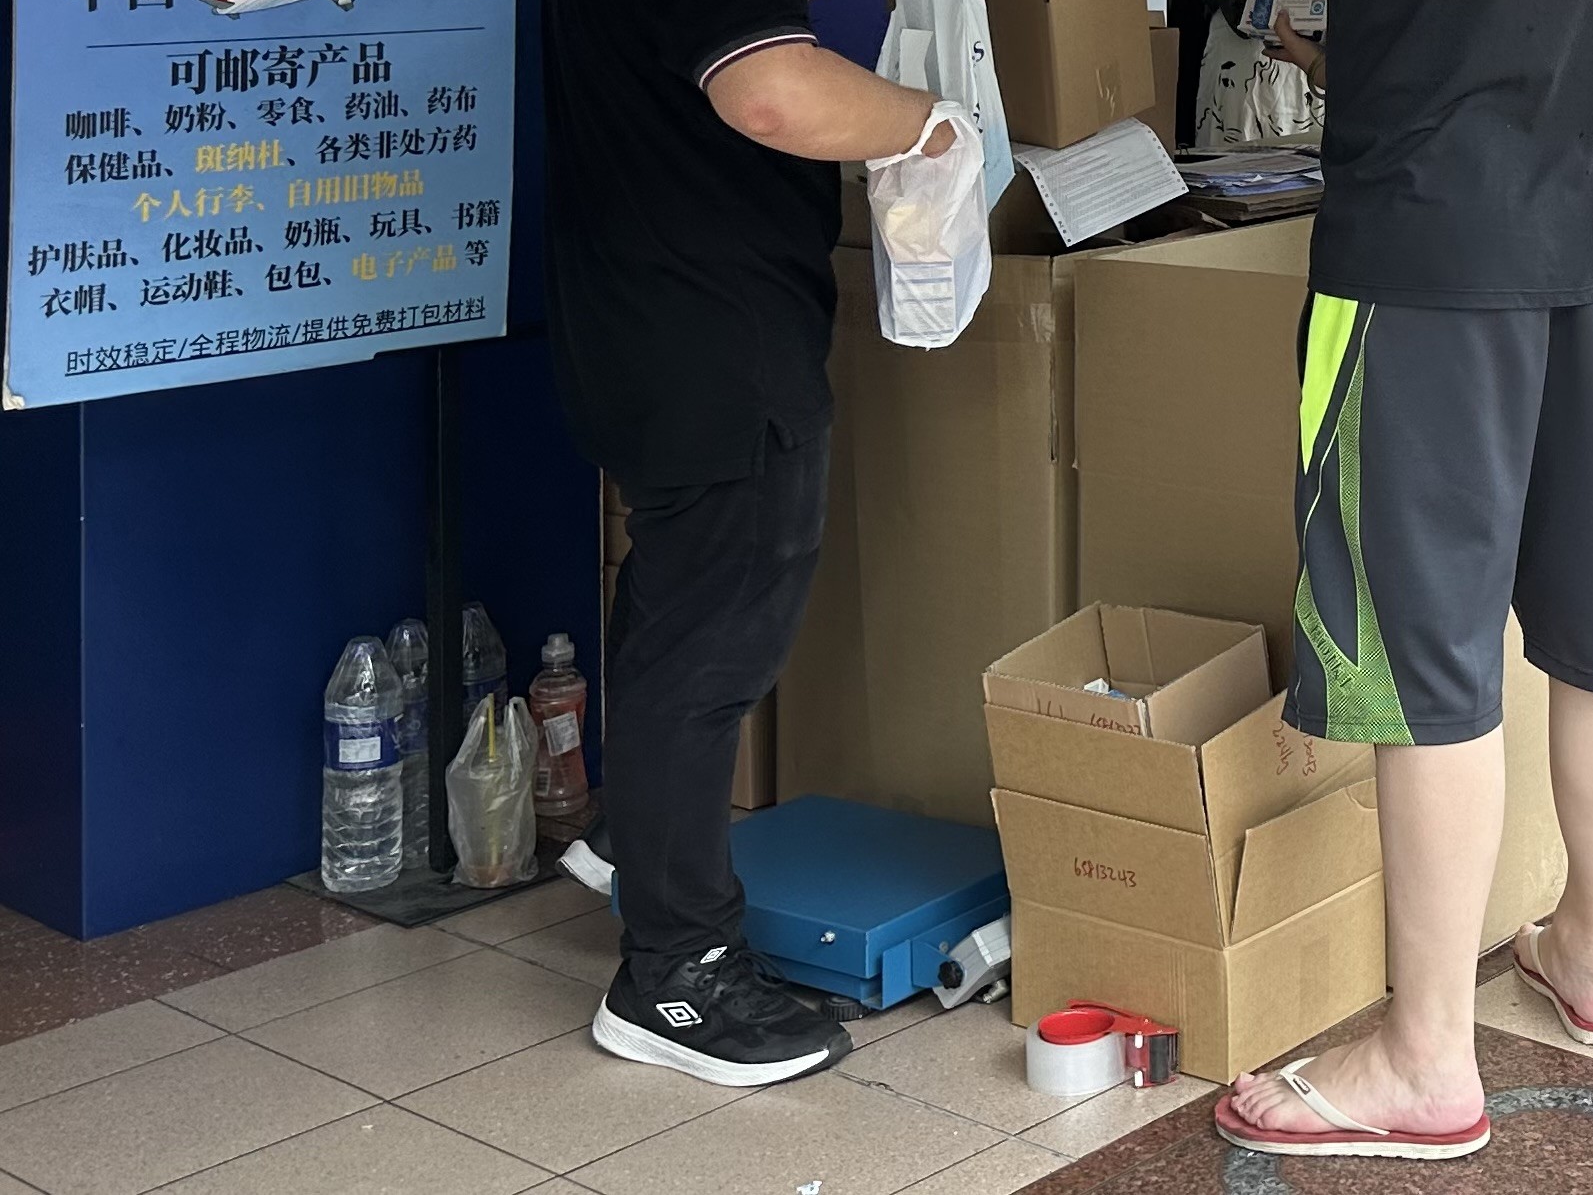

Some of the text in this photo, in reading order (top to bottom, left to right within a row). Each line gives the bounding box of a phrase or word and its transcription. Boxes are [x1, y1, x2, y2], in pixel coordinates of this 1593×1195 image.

[166, 41, 393, 95] 可邮寄产品
